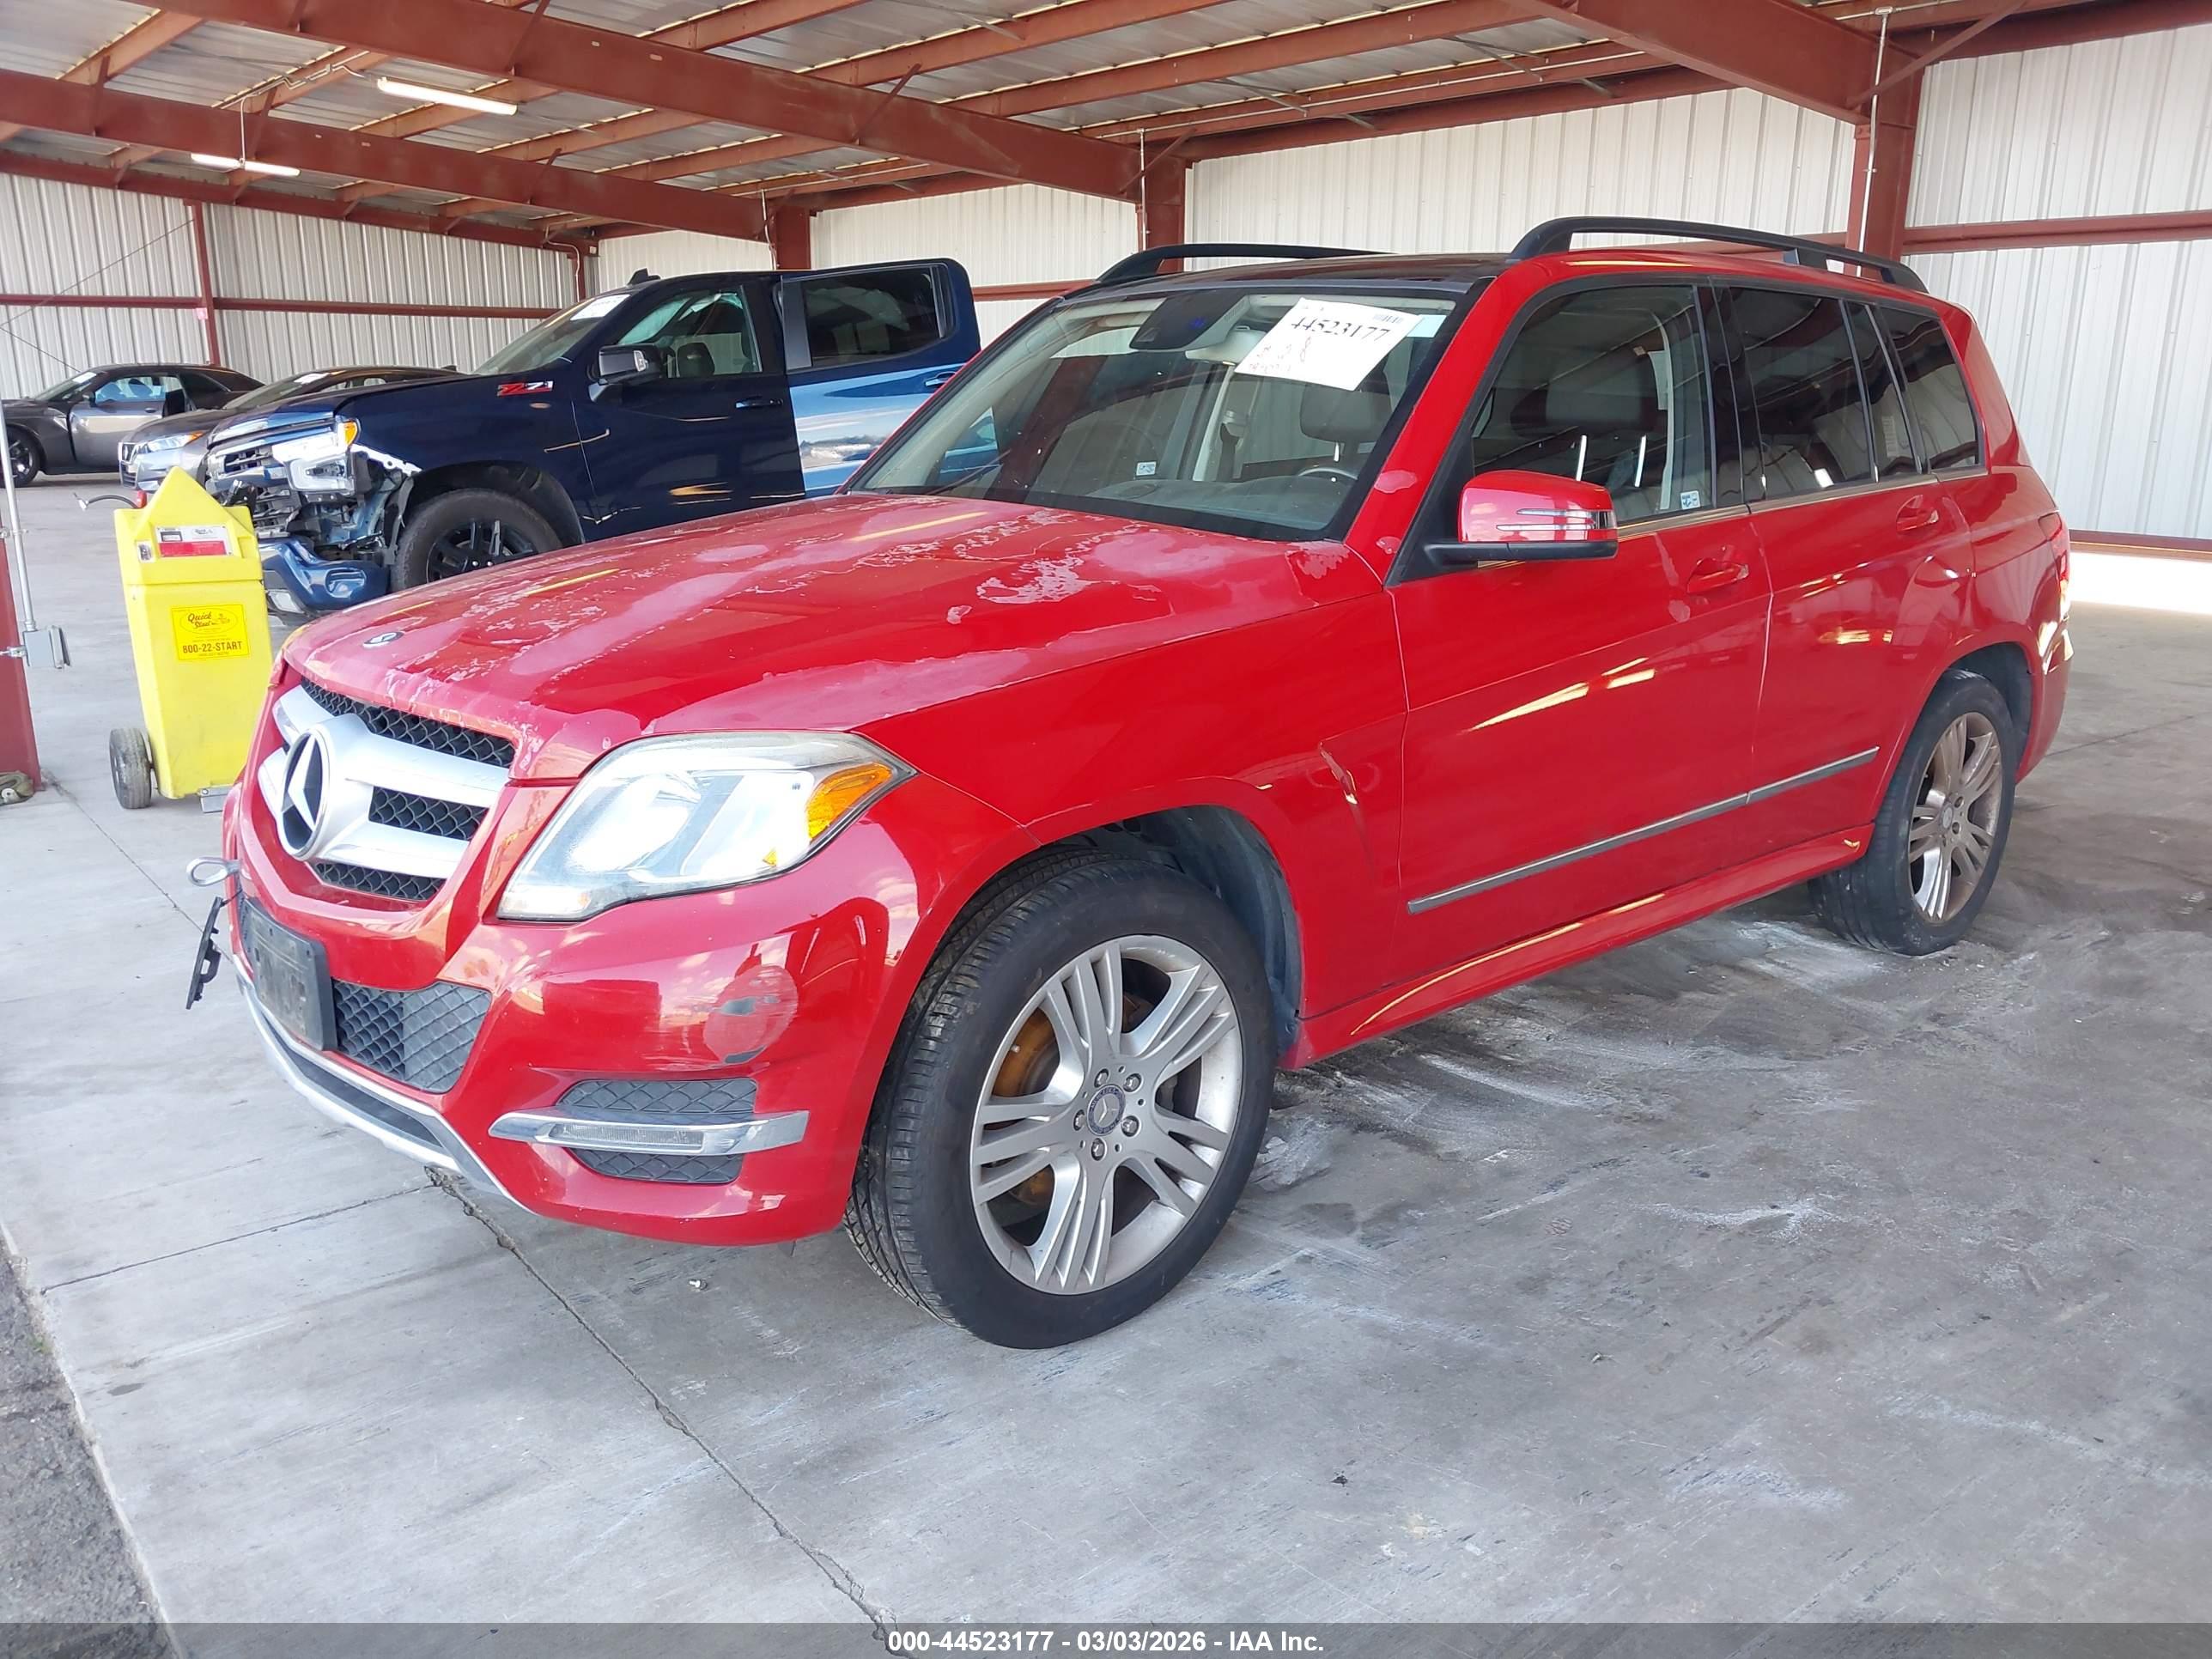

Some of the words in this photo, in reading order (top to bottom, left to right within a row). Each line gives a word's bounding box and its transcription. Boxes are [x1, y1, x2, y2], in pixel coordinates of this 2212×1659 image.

[1291, 316, 1391, 342] 44523177
[497, 380, 554, 396] Z71
[187, 611, 212, 623] Quick
[182, 641, 243, 653] 800-22-START
